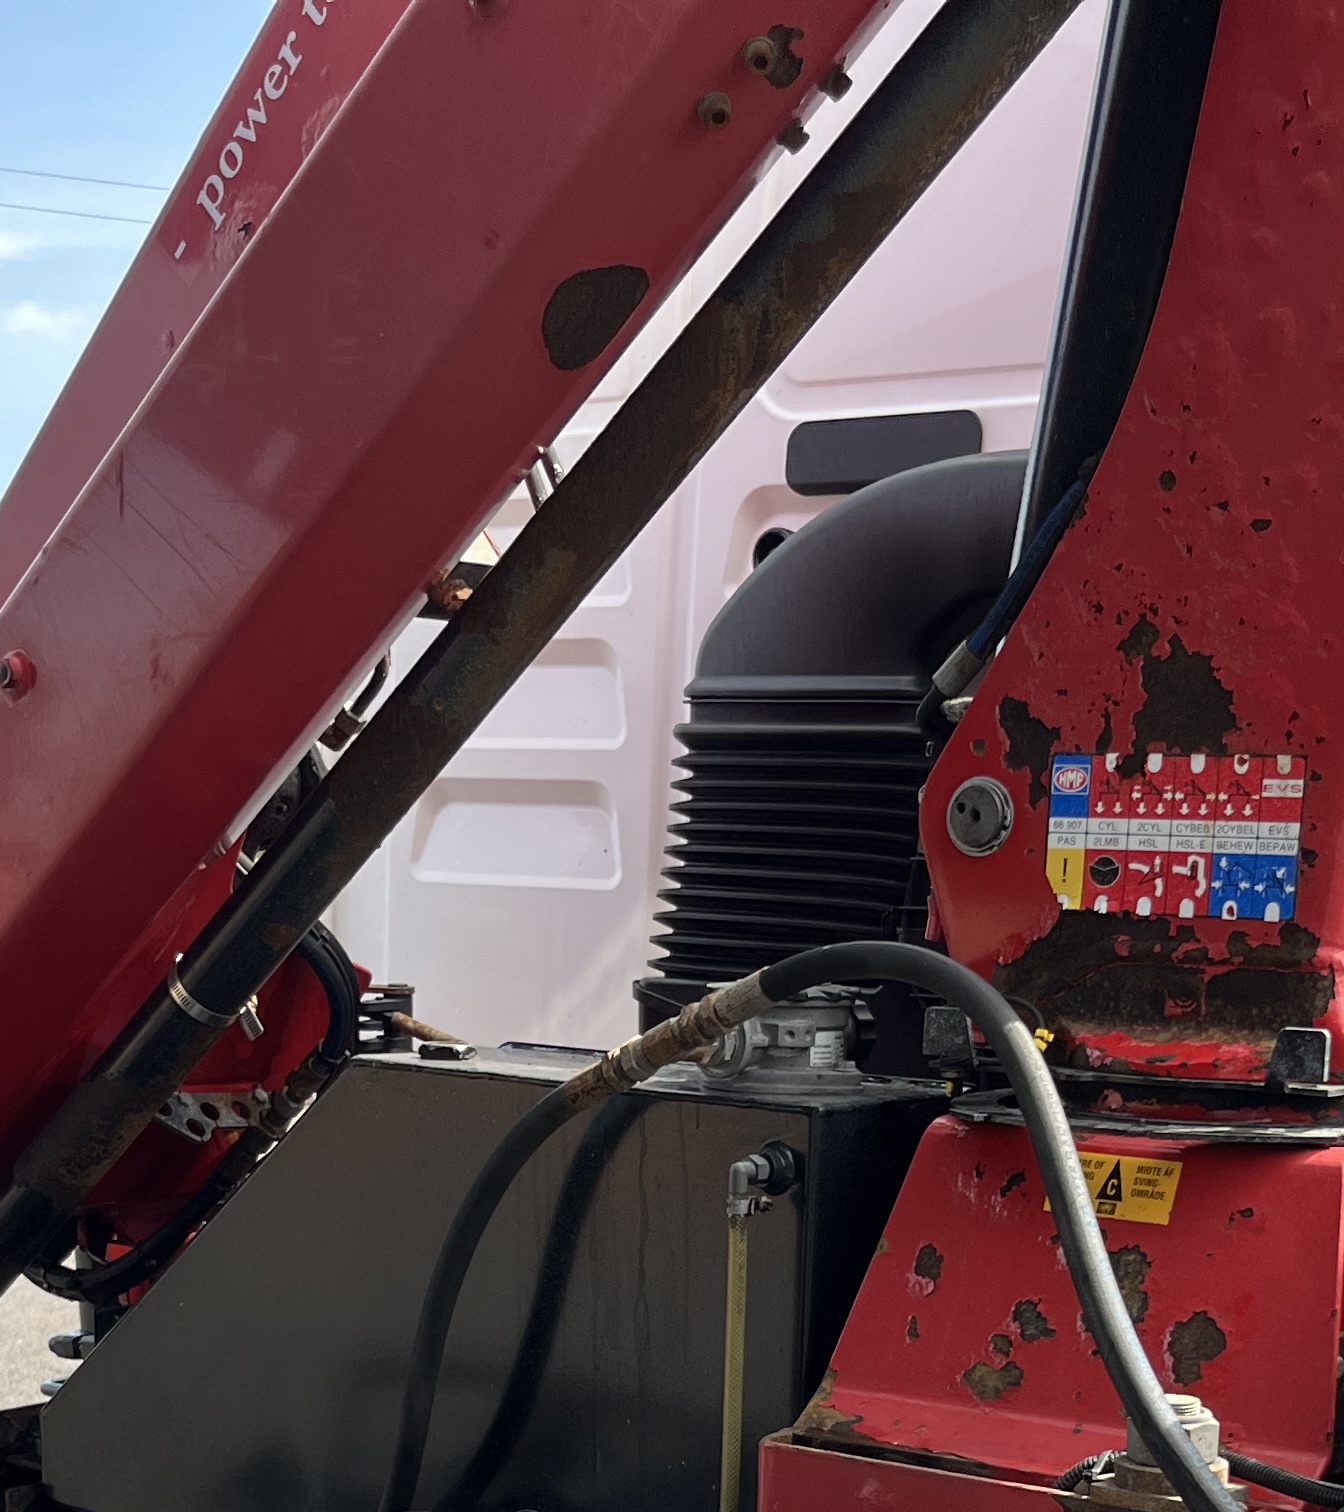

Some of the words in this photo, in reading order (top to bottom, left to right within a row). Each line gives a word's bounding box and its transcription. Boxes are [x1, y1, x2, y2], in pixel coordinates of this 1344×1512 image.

[196, 30, 303, 231] power
[1263, 783, 1302, 793] EVS
[1097, 821, 1117, 832] CYL
[1136, 822, 1162, 833] 2CYL
[1216, 824, 1256, 835] 2CYBEL
[1268, 825, 1290, 836] EVS
[1056, 835, 1076, 846] PAS
[1138, 838, 1158, 849] HSL
[1094, 1160, 1106, 1170] OF
[1136, 1165, 1163, 1176] MIDTE
[1106, 1178, 1119, 1196] C
